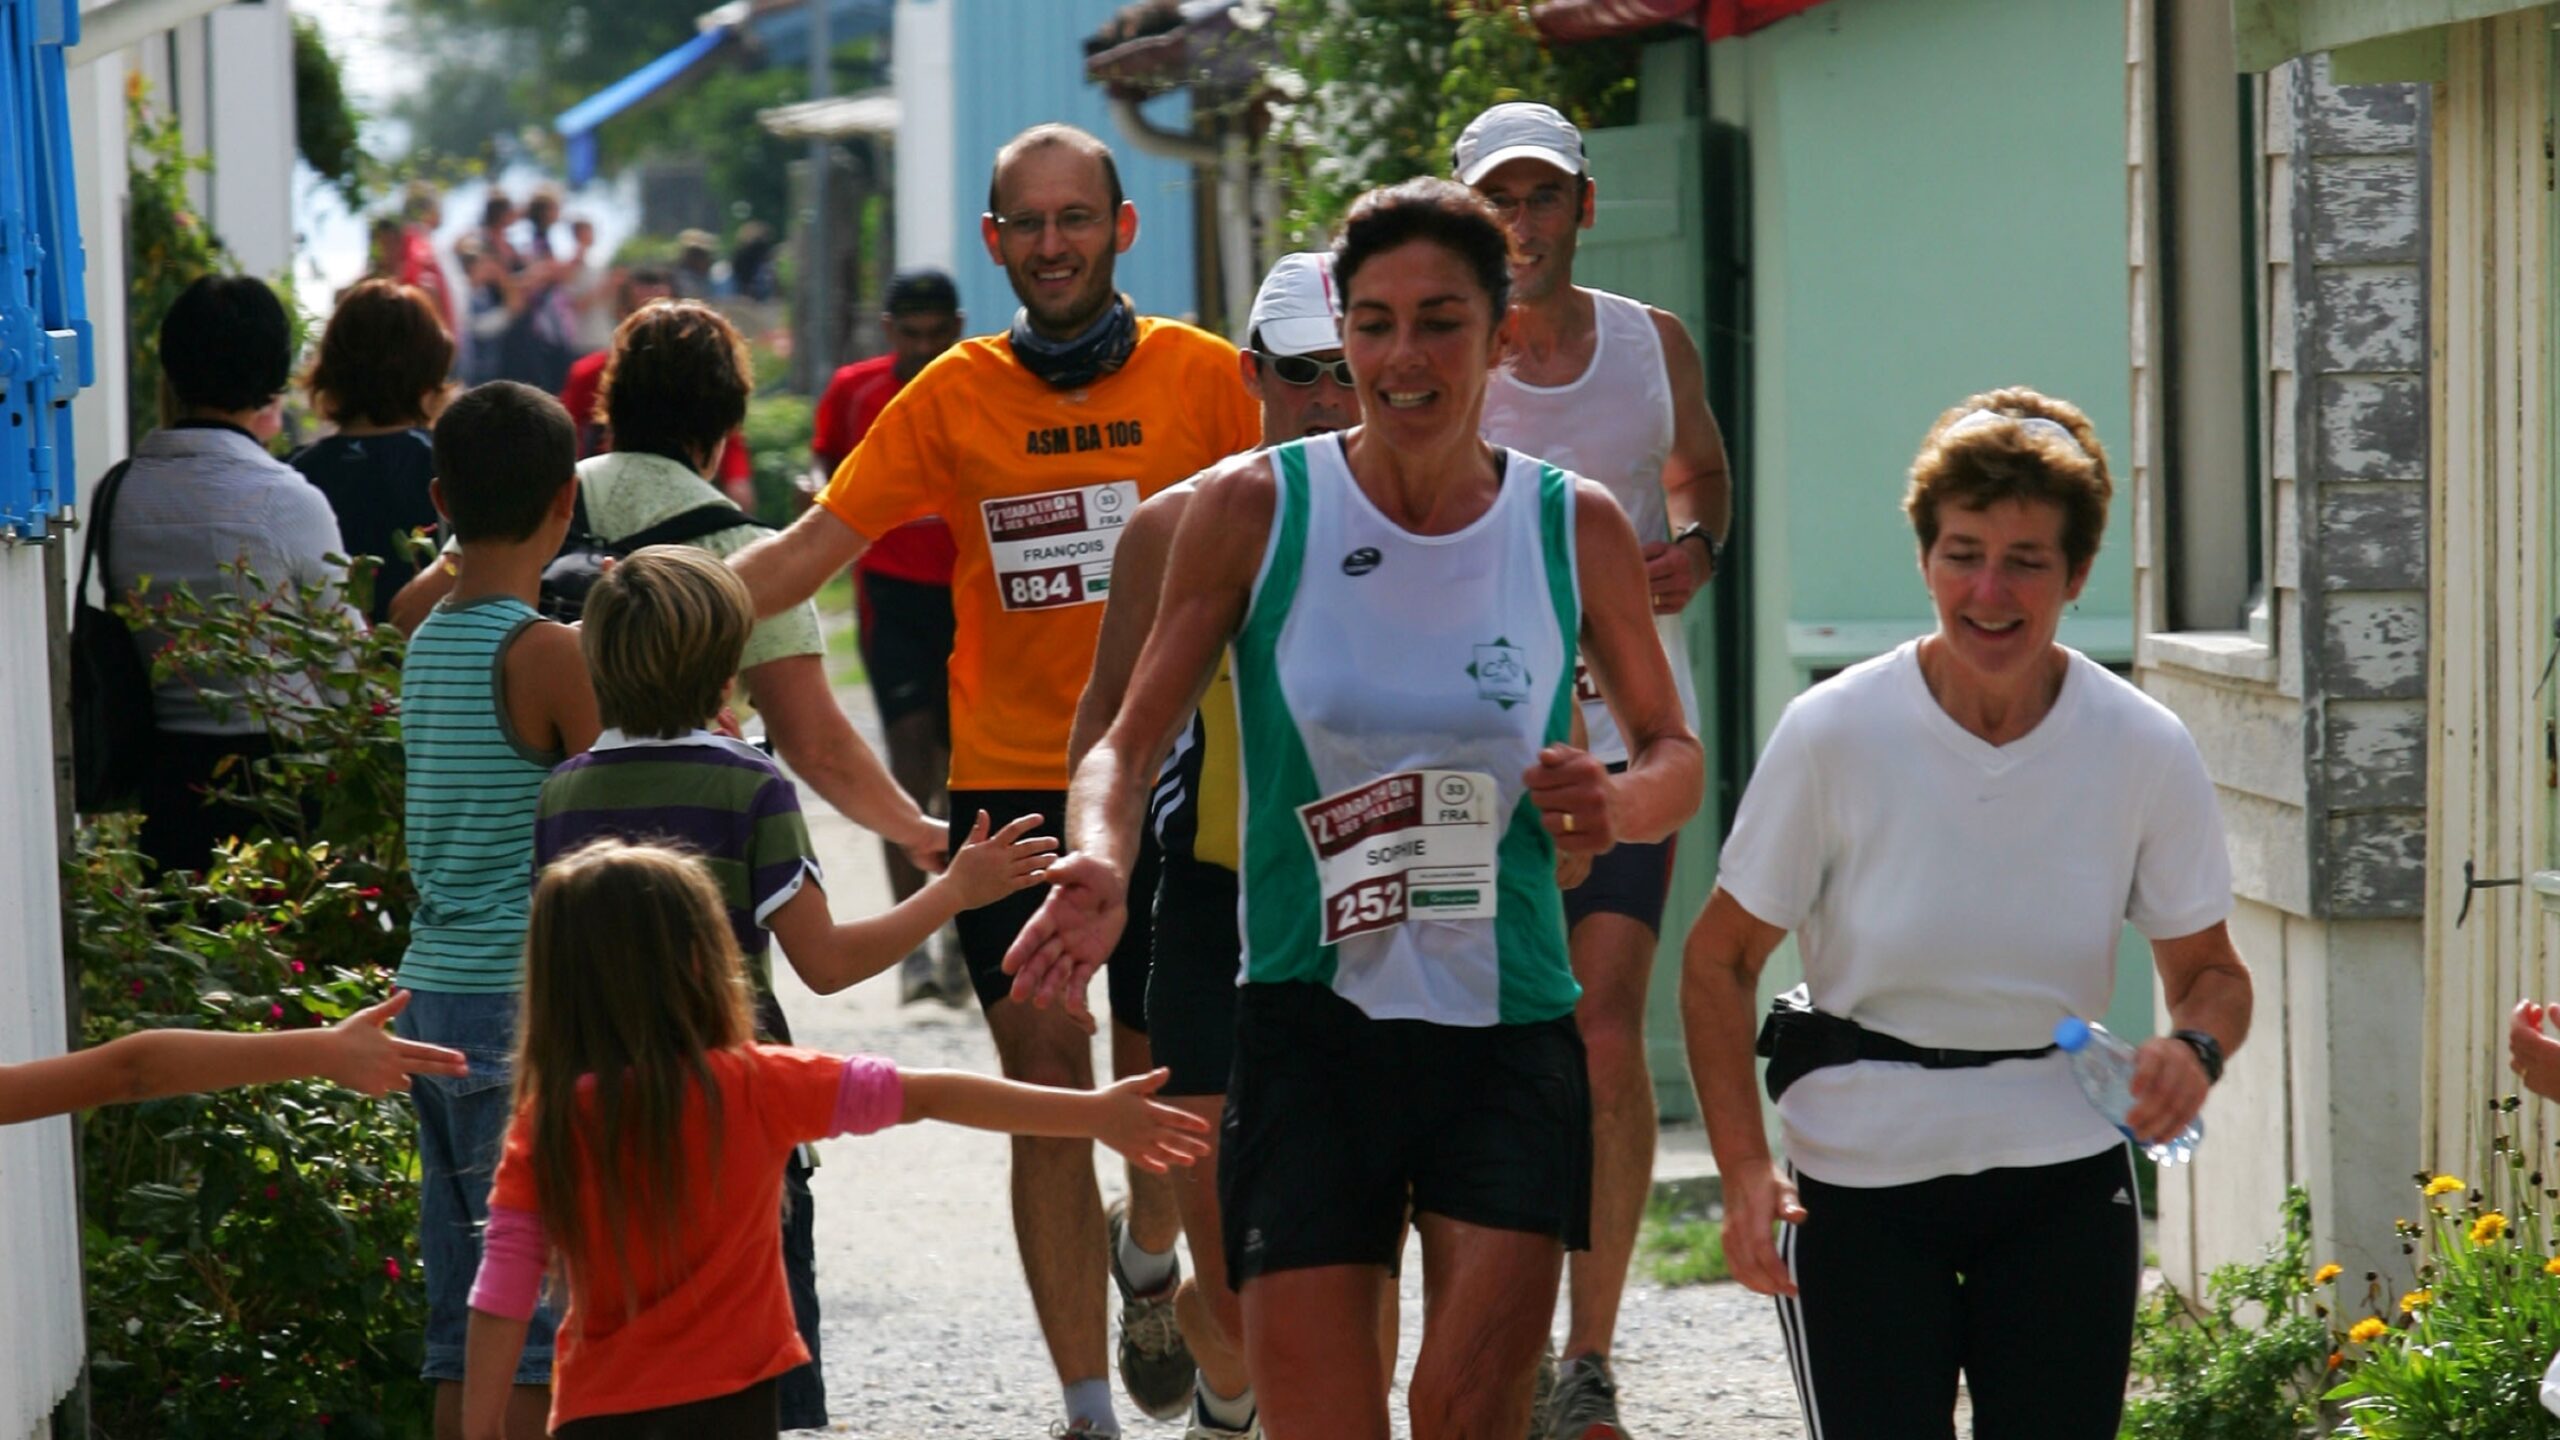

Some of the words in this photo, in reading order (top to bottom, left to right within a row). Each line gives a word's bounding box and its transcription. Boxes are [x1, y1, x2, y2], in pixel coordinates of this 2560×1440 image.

[1028, 429, 1070, 454] ASM
[1076, 425, 1102, 450] BA
[1107, 421, 1142, 447] 106
[1002, 495, 1077, 519] MARATHON
[1101, 495, 1116, 506] 33
[1005, 518, 1024, 530] DES
[1028, 510, 1078, 525] VILLAGES
[1099, 515, 1123, 526] FRA
[1024, 541, 1104, 561] FRANÇOIS
[1011, 573, 1071, 603] 884
[1447, 784, 1465, 796] 33
[1438, 809, 1470, 822] FRA
[1366, 839, 1427, 866] SOPHIE
[1337, 882, 1403, 930] 252
